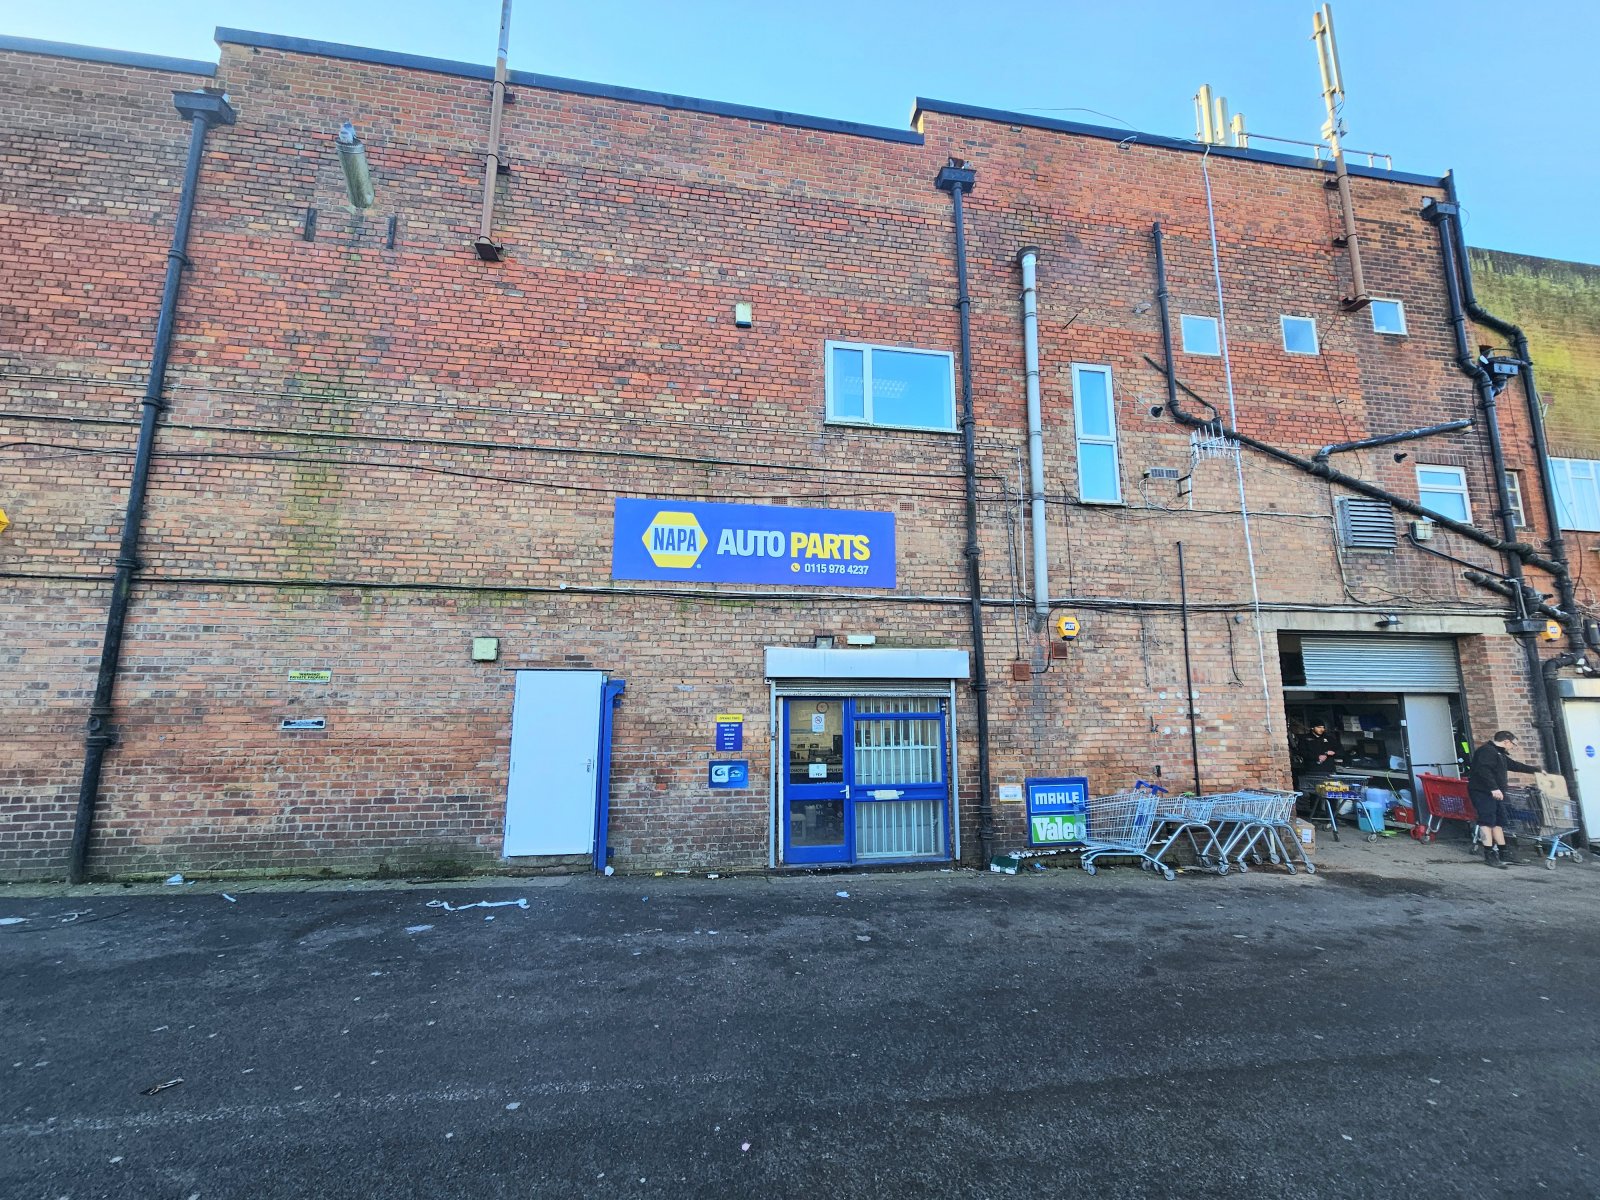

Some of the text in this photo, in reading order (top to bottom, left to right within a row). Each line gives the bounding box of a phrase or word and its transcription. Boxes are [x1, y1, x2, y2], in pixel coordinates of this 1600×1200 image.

[653, 527, 697, 552] NAPA
[717, 528, 871, 561] AUTO PARTS
[804, 563, 869, 575] 0115 978 4237
[1035, 792, 1080, 804] MAHLE
[1032, 817, 1086, 840] Valeo
